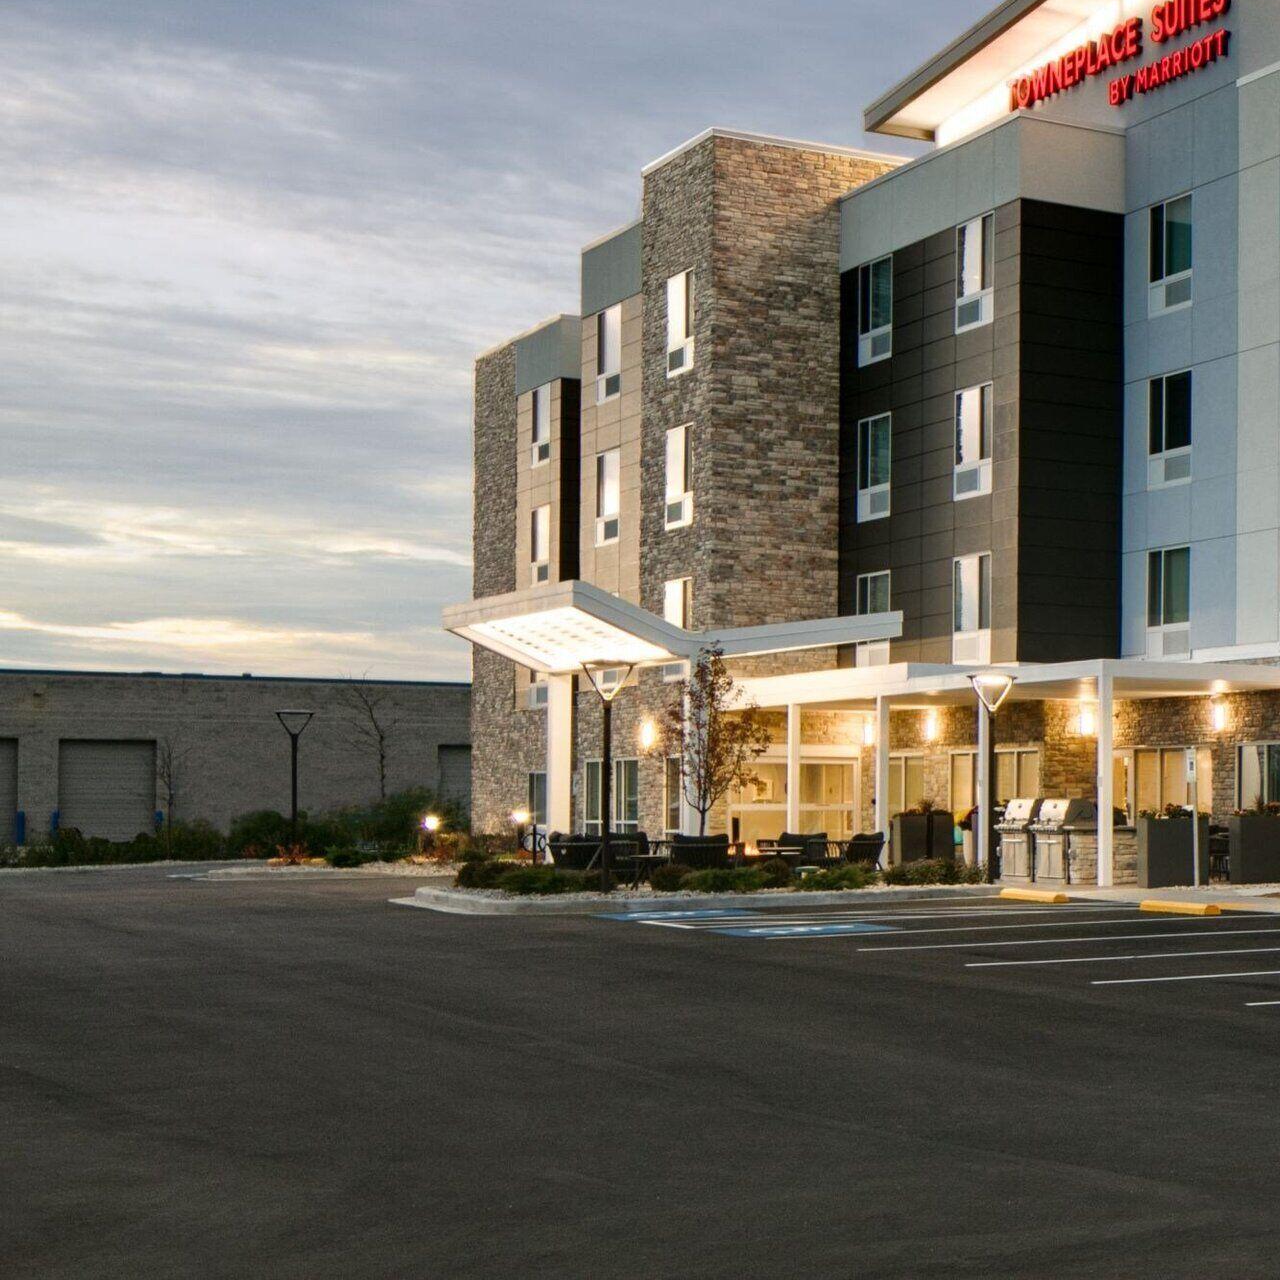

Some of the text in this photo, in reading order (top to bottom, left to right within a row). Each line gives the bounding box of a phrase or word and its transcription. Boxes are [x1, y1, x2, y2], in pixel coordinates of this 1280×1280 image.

[1008, 16, 1143, 113] TOWNEPLACE
[1107, 27, 1231, 107] BY MARRIOTT
